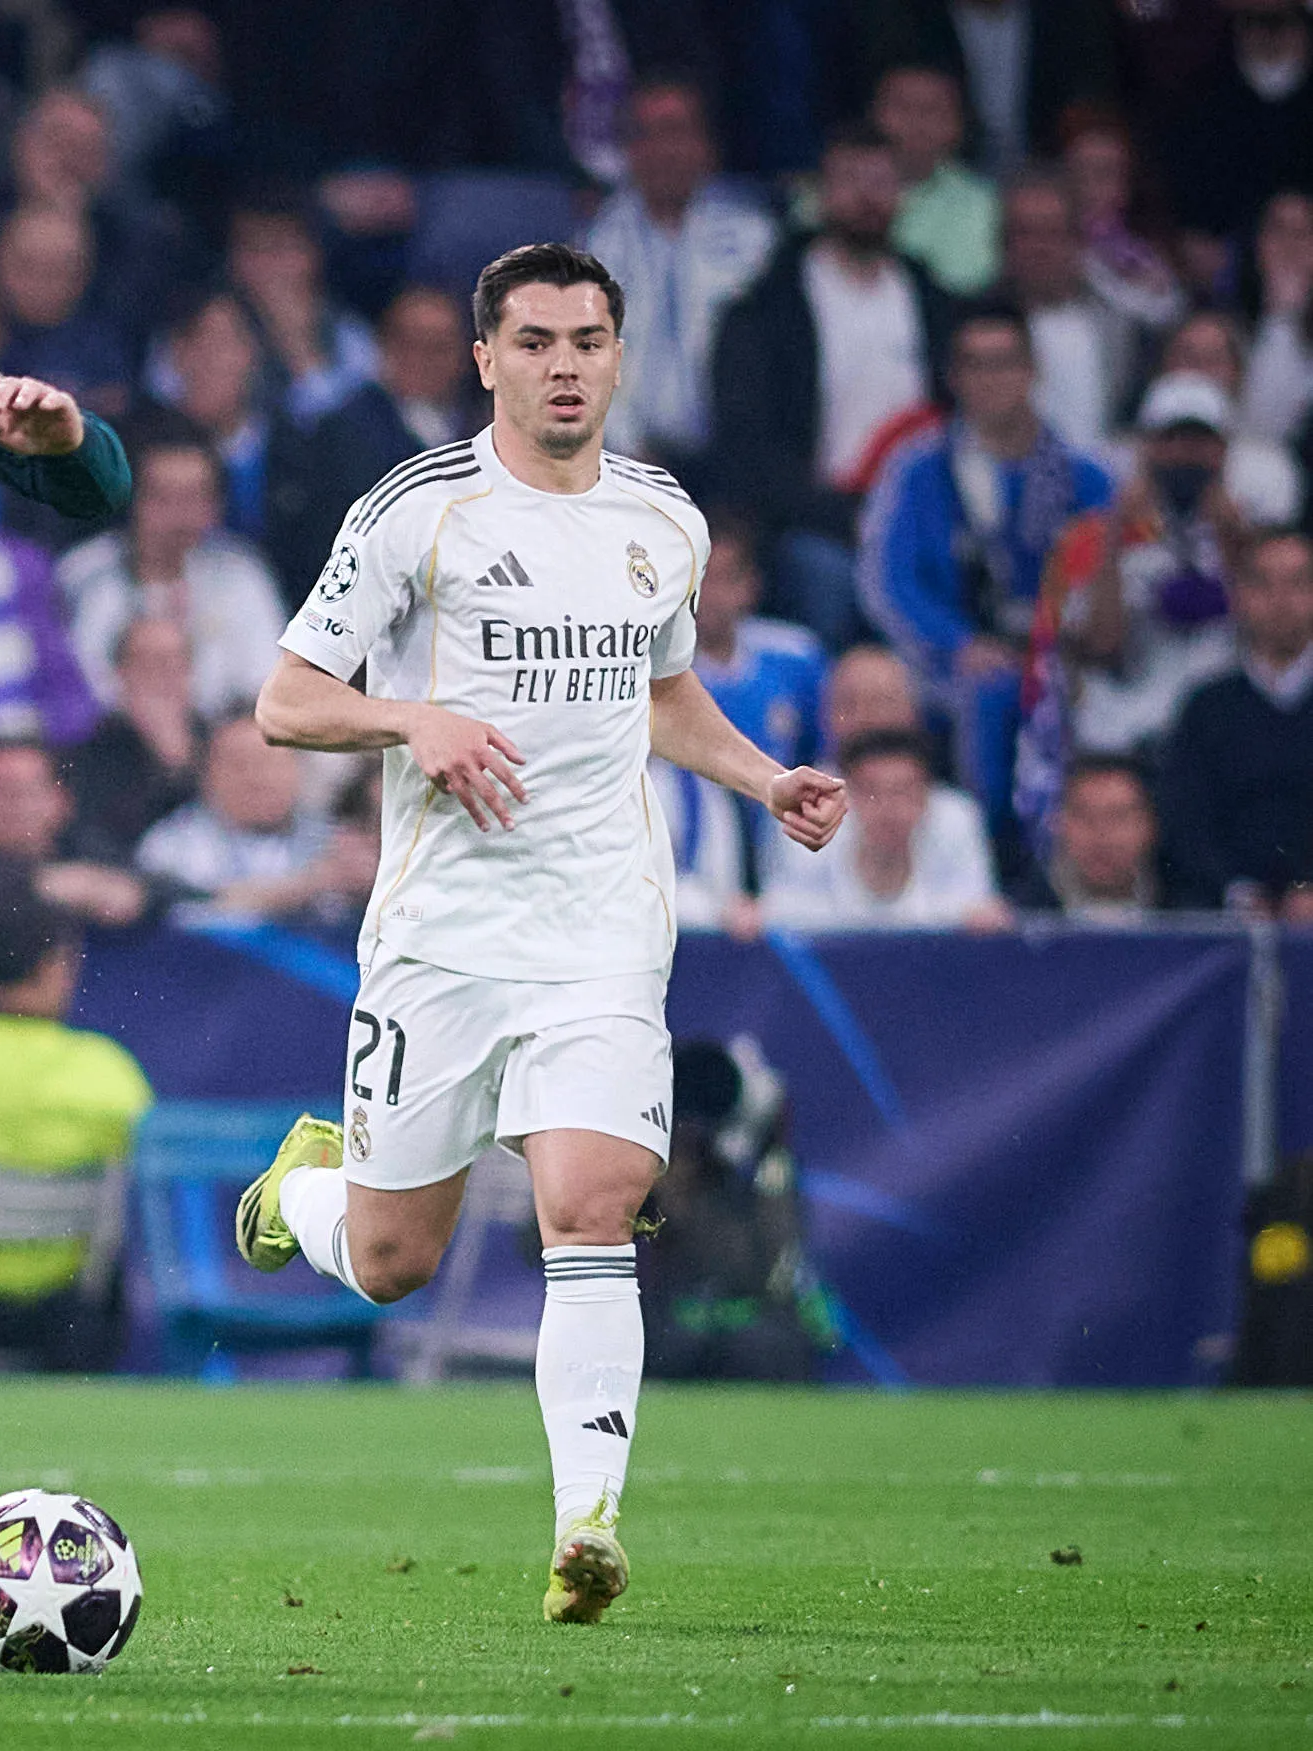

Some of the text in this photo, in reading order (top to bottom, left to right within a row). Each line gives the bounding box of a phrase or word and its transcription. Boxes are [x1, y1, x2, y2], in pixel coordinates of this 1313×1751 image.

[512, 666, 636, 703] FLY BETTER
[352, 1008, 406, 1106] 21
